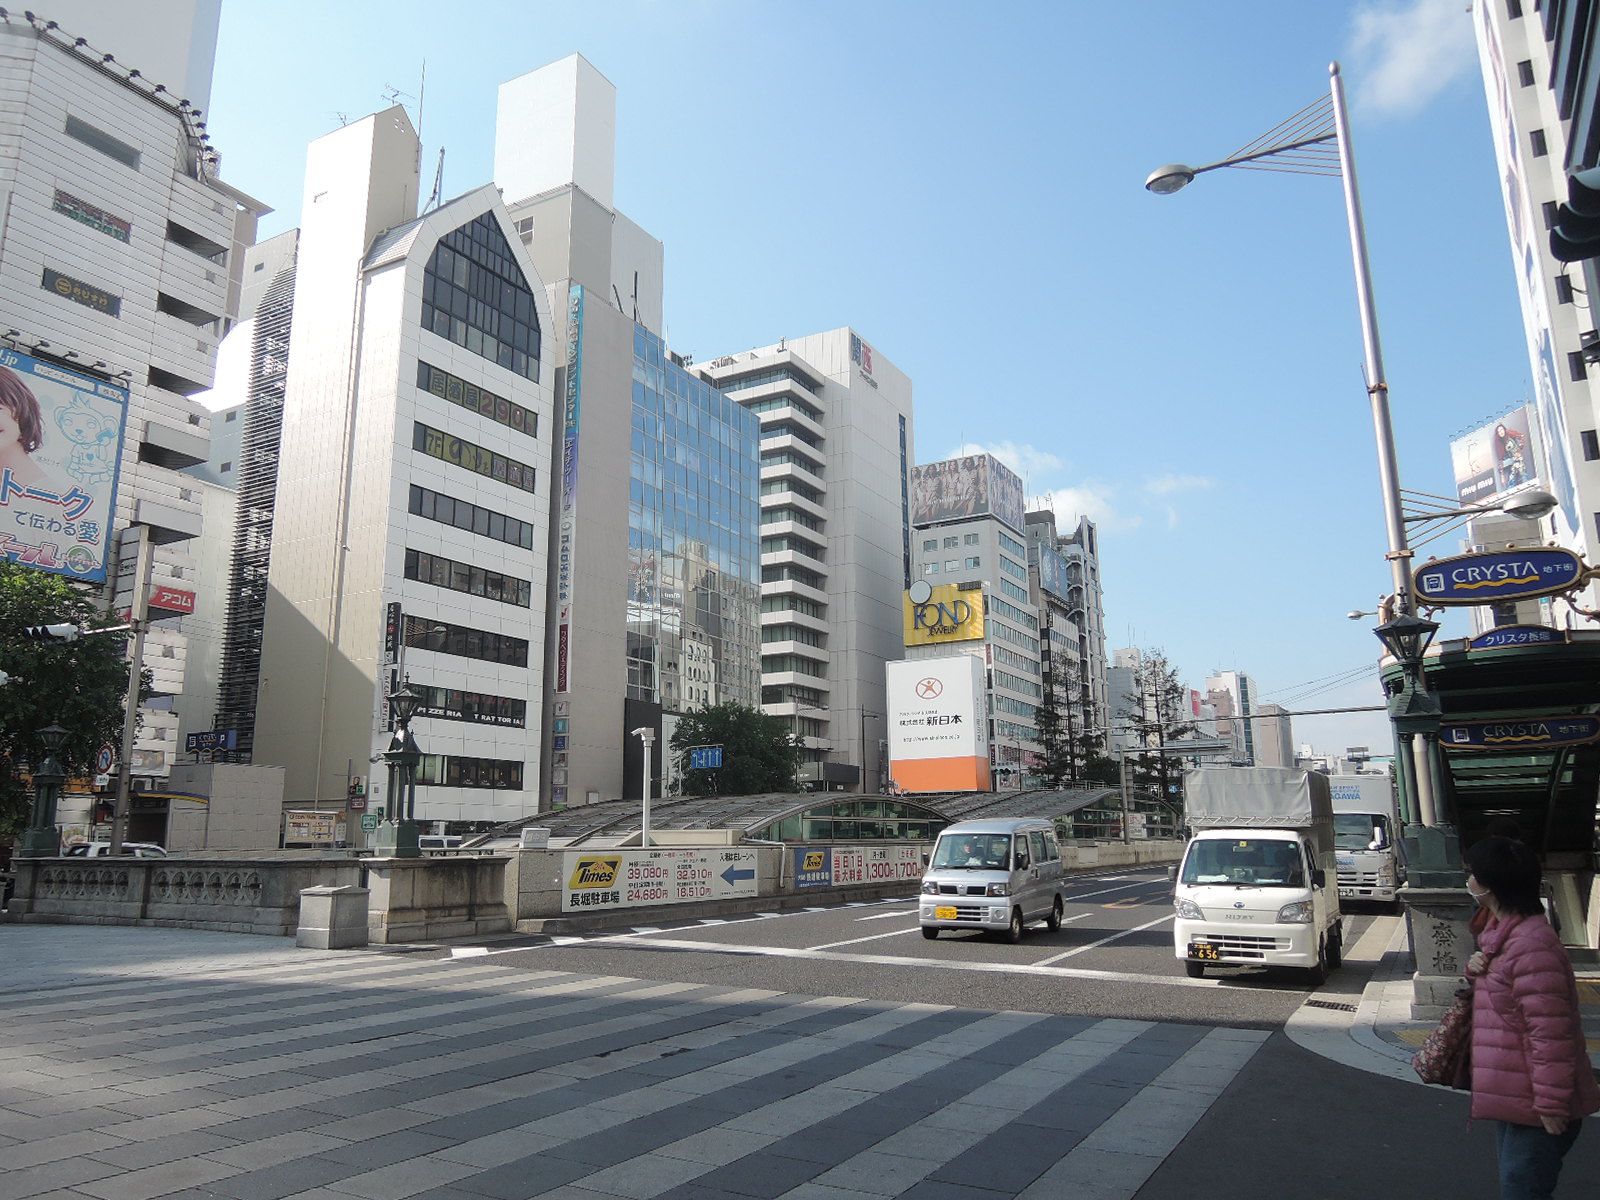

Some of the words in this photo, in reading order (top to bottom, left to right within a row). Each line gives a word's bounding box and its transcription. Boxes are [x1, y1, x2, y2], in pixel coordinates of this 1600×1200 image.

[0, 467, 93, 520] トーク
[13, 510, 100, 545] で伝わる愛
[1452, 561, 1538, 583] CRYSTA
[1543, 563, 1573, 574] 地下街
[160, 591, 192, 607] アコム
[913, 599, 971, 630] FOND
[926, 714, 963, 726] 新日本
[1482, 723, 1550, 737] CRYSTA
[578, 867, 613, 883] Times
[627, 867, 669, 880] 39,080円
[569, 891, 620, 907] 長堀駐車場
[627, 888, 669, 902] 24,680円
